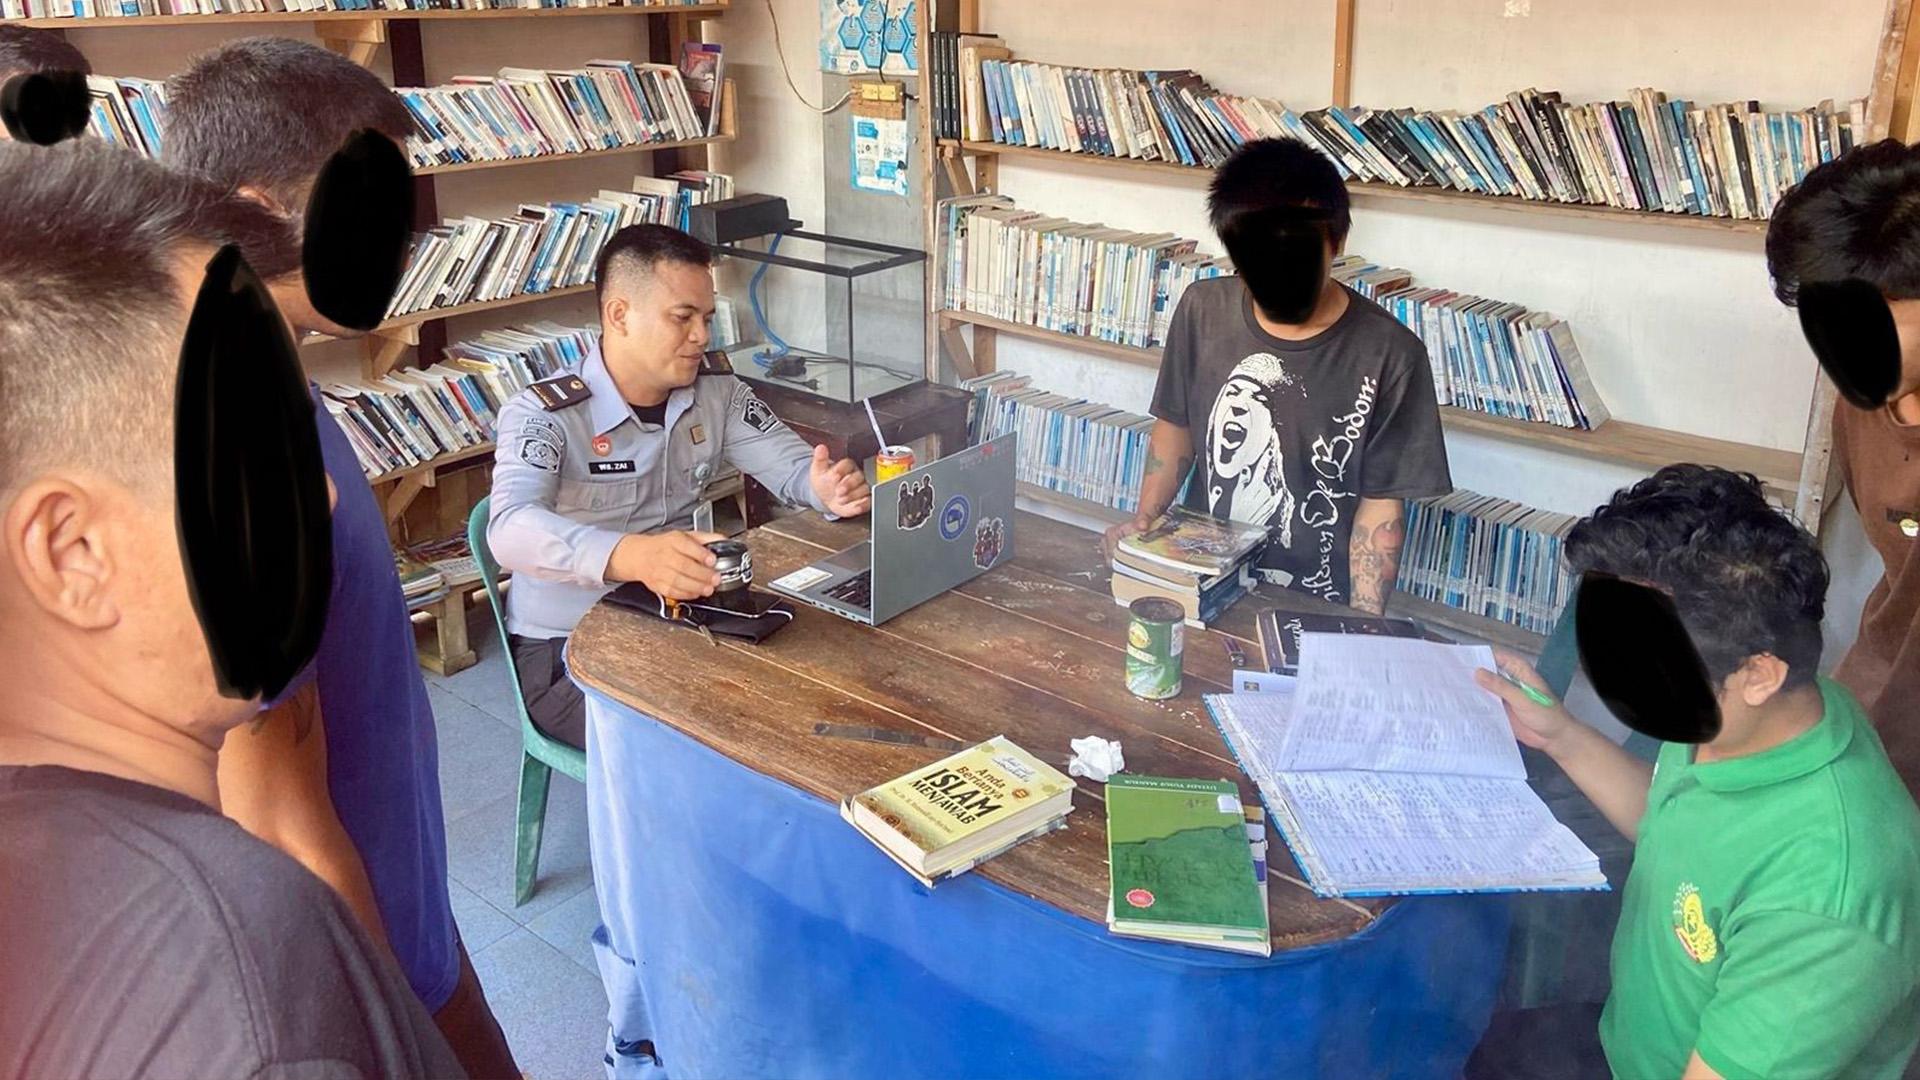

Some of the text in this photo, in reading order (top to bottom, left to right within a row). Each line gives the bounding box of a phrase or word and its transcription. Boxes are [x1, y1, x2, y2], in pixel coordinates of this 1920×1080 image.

[614, 462, 628, 470] ZAI
[922, 768, 1004, 818] ISLAM
[956, 766, 1005, 800] Bertanya
[975, 767, 1007, 788] Anda
[908, 780, 979, 825] MENJAWAB
